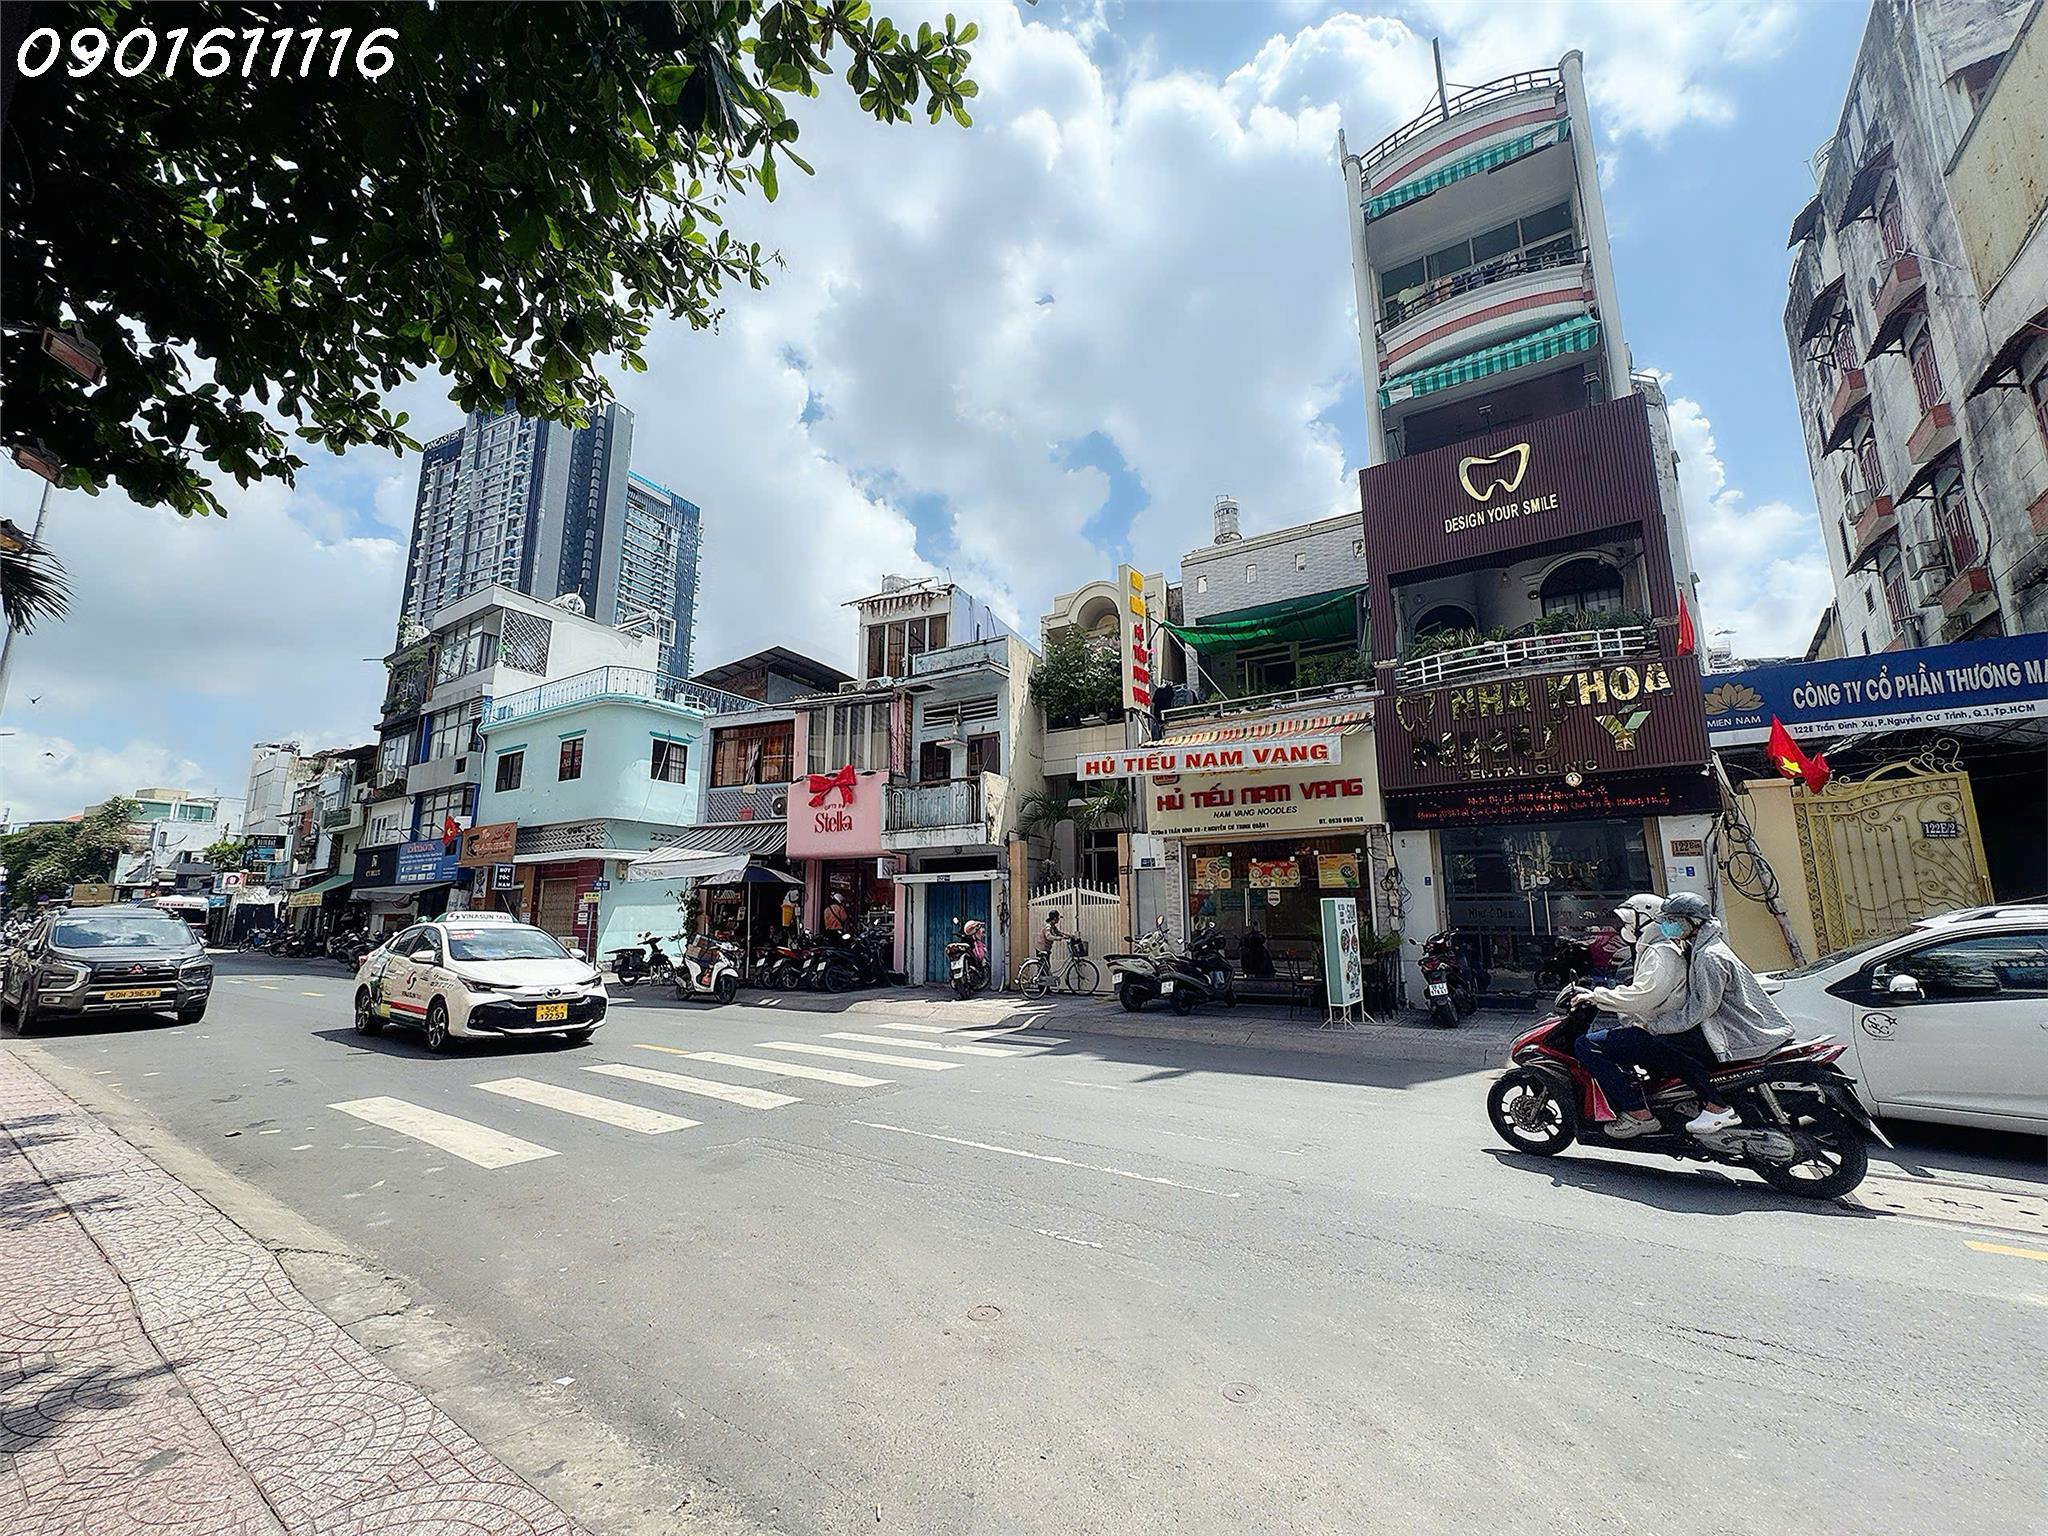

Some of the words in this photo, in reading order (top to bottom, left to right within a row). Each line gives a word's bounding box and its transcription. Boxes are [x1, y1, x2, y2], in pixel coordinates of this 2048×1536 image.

[1444, 511, 1486, 534] DESIGN
[1487, 503, 1519, 523] YOUR
[1523, 494, 1558, 515] SMILE
[1546, 663, 1674, 709] KHOA
[1793, 680, 1841, 709] CÔNG
[1842, 681, 1861, 704] TY
[1866, 664, 1893, 702] CỔ
[1896, 662, 1944, 699] PHẦN
[1946, 662, 2022, 695] THƯƠNG
[2024, 658, 2048, 685] M
[1736, 715, 1762, 725] NAM
[1794, 725, 1813, 734] 122E
[1085, 755, 1116, 776] HỦ
[1124, 752, 1176, 772] TIẾU
[1185, 750, 1243, 769] NAM
[1252, 744, 1329, 764] VANG
[1461, 766, 1530, 781] DENTAL
[1156, 788, 1184, 811] HỦ
[1191, 783, 1234, 808] TIẾU
[1241, 784, 1291, 804] NAM
[1299, 778, 1363, 800] VANG
[815, 811, 853, 833] Stella
[1213, 810, 1231, 819] NAM
[1234, 808, 1255, 817] VANG
[1257, 806, 1298, 816] NOODLES
